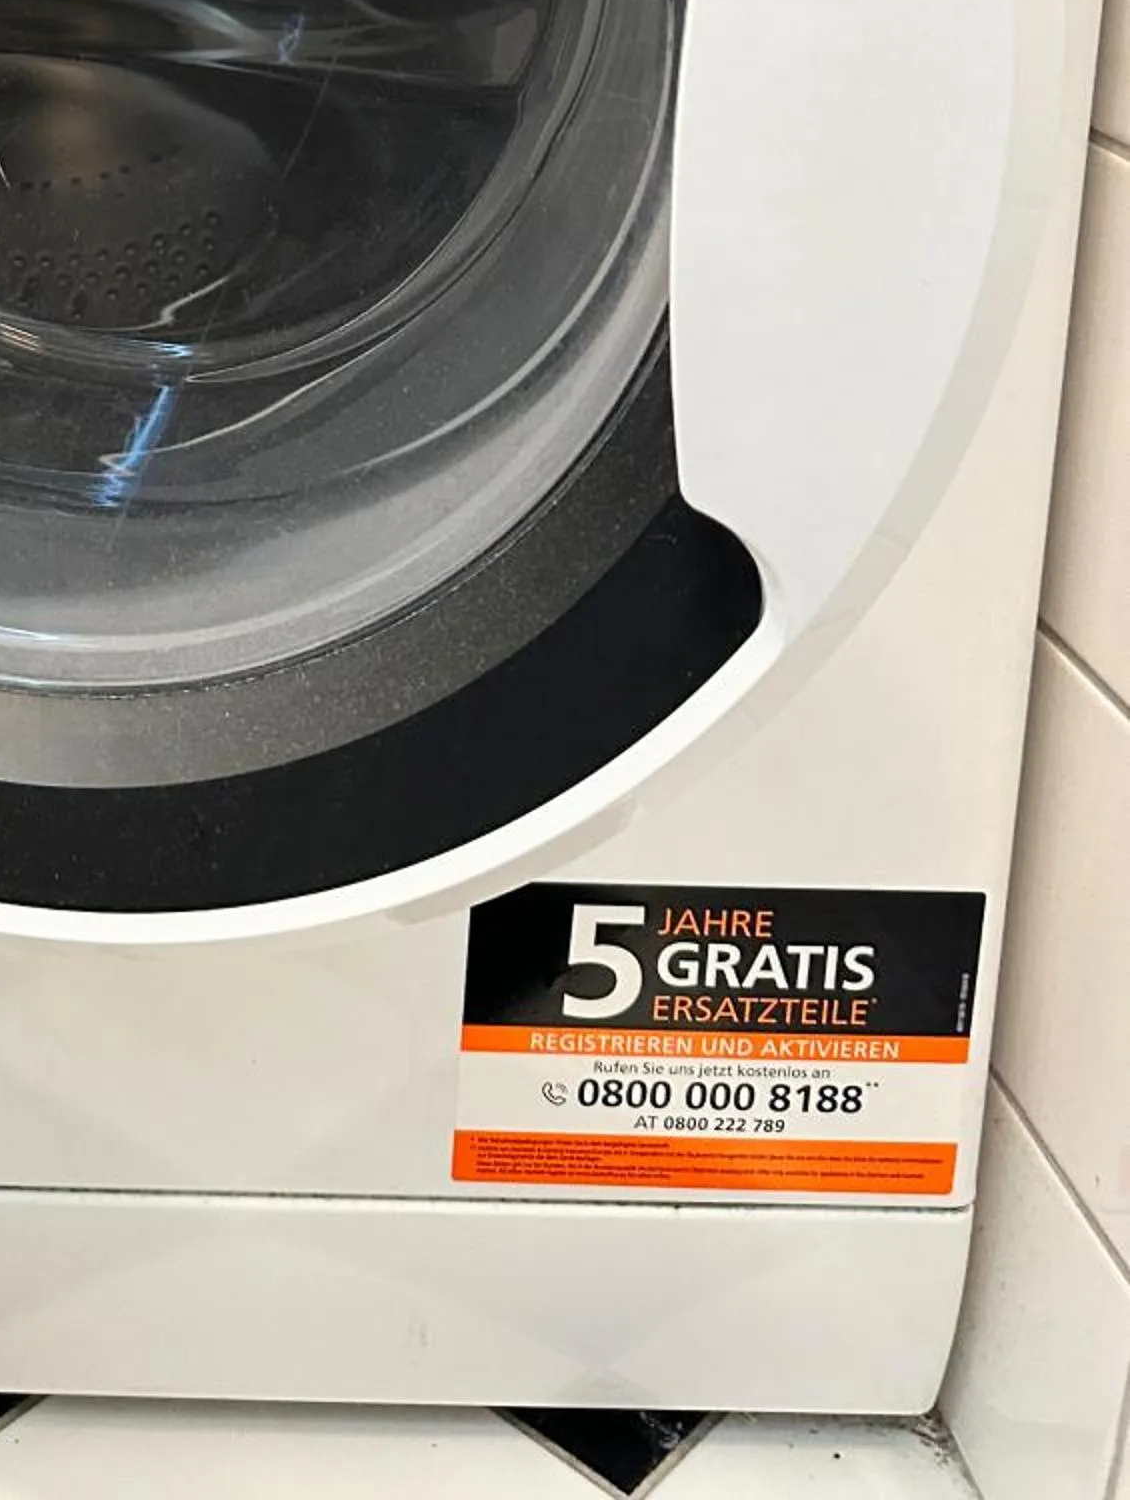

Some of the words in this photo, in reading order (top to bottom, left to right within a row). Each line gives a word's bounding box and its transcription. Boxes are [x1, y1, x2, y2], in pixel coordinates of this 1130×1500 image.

[658, 908, 774, 938] JAHRE
[562, 903, 646, 1019] 5
[657, 941, 875, 991] GRATIS
[530, 1032, 693, 1056] REGISTRIEREN
[701, 1036, 753, 1057] UND
[760, 1039, 901, 1061] AKTIVIEREN
[593, 1061, 639, 1075] Rufen
[642, 1061, 666, 1076] Sie
[669, 1065, 695, 1077] uns
[697, 1064, 733, 1081] jetzt
[737, 1065, 808, 1080] kostenlos
[811, 1068, 831, 1080] an
[577, 1078, 670, 1109] 0800
[685, 1082, 755, 1111] 000
[634, 1115, 657, 1130] AT
[663, 1116, 708, 1131] 0800
[714, 1117, 746, 1133] 222
[752, 1118, 785, 1134] 789
